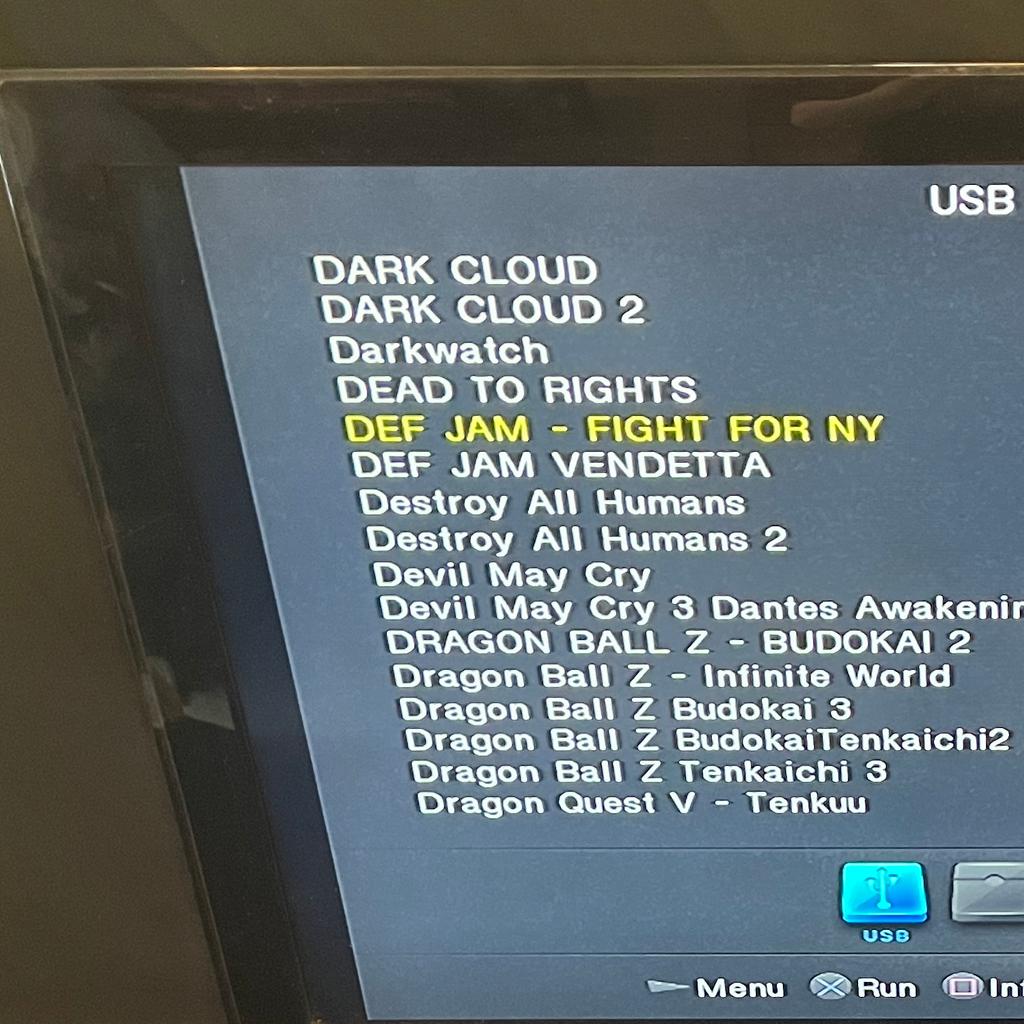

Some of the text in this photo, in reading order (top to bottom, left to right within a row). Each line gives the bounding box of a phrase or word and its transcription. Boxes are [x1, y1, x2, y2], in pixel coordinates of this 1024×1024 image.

[930, 184, 1015, 216] USB
[313, 255, 598, 285] DARK CLOUD
[321, 294, 645, 325] DARK CLOUD 2
[329, 335, 549, 365] Darkwatch
[337, 375, 697, 404] DEAD TO RIGHTS
[344, 414, 425, 442] DEF
[444, 415, 530, 443] JAM
[587, 415, 709, 443] FIGHT
[729, 415, 811, 443] FOR
[828, 414, 884, 443] NY
[351, 451, 771, 479] DEF JAM VENDETTA
[359, 488, 746, 522] Destroy All Humans
[366, 525, 788, 558] Destroy All Humans 2
[373, 561, 651, 593] Devil May Cry
[379, 595, 476, 620] Devil
[494, 595, 573, 626] May
[589, 595, 655, 626] Cry
[671, 595, 694, 620] 3
[711, 595, 839, 620] Dantes
[386, 629, 551, 655] DRAGON
[569, 630, 671, 655] BALL
[685, 630, 710, 655] Z
[763, 630, 931, 655] BUDOKAI
[949, 629, 971, 654] 2
[392, 664, 525, 694] Dragon
[540, 664, 610, 688] Ball
[627, 663, 652, 688] Z
[704, 664, 830, 688] Infinite
[845, 663, 951, 688] World
[399, 697, 852, 726] Dragon Ball Z Budokai 3
[405, 727, 1010, 757] Dragon Ball Z BudokaiTenkaichi2
[411, 760, 887, 788] Dragon Ball Z Tenkaichi 3
[417, 791, 545, 819] Dragon
[558, 791, 656, 814] Quest
[669, 791, 696, 814] V
[745, 791, 866, 814] Tenkuu
[862, 929, 911, 944] USB
[696, 978, 784, 998] Menu
[857, 977, 917, 998] Run
